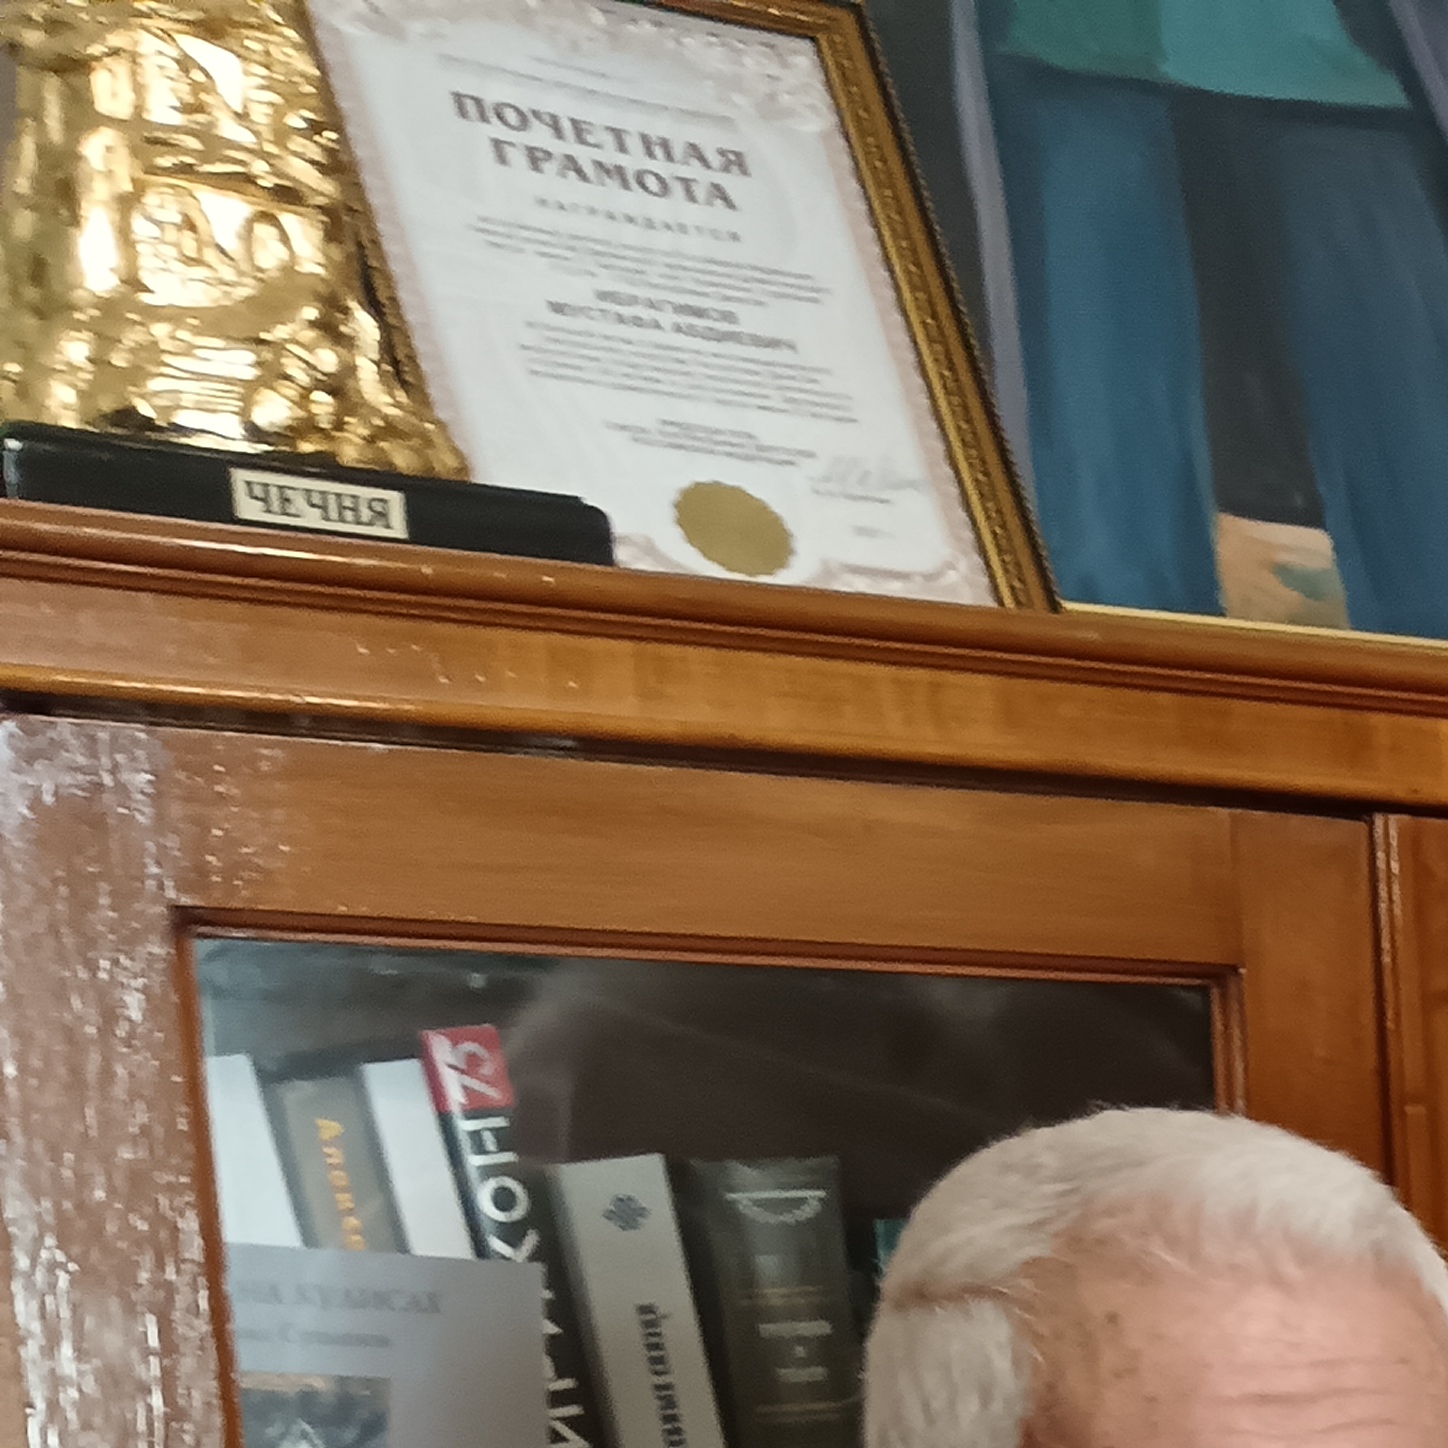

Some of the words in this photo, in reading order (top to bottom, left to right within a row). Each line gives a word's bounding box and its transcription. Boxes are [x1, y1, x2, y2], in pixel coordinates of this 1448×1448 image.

[450, 90, 752, 177] ПОЧЕТНАЯ
[490, 137, 739, 211] ГРАМОТА
[245, 480, 391, 529] ЧЕЧНЯ
